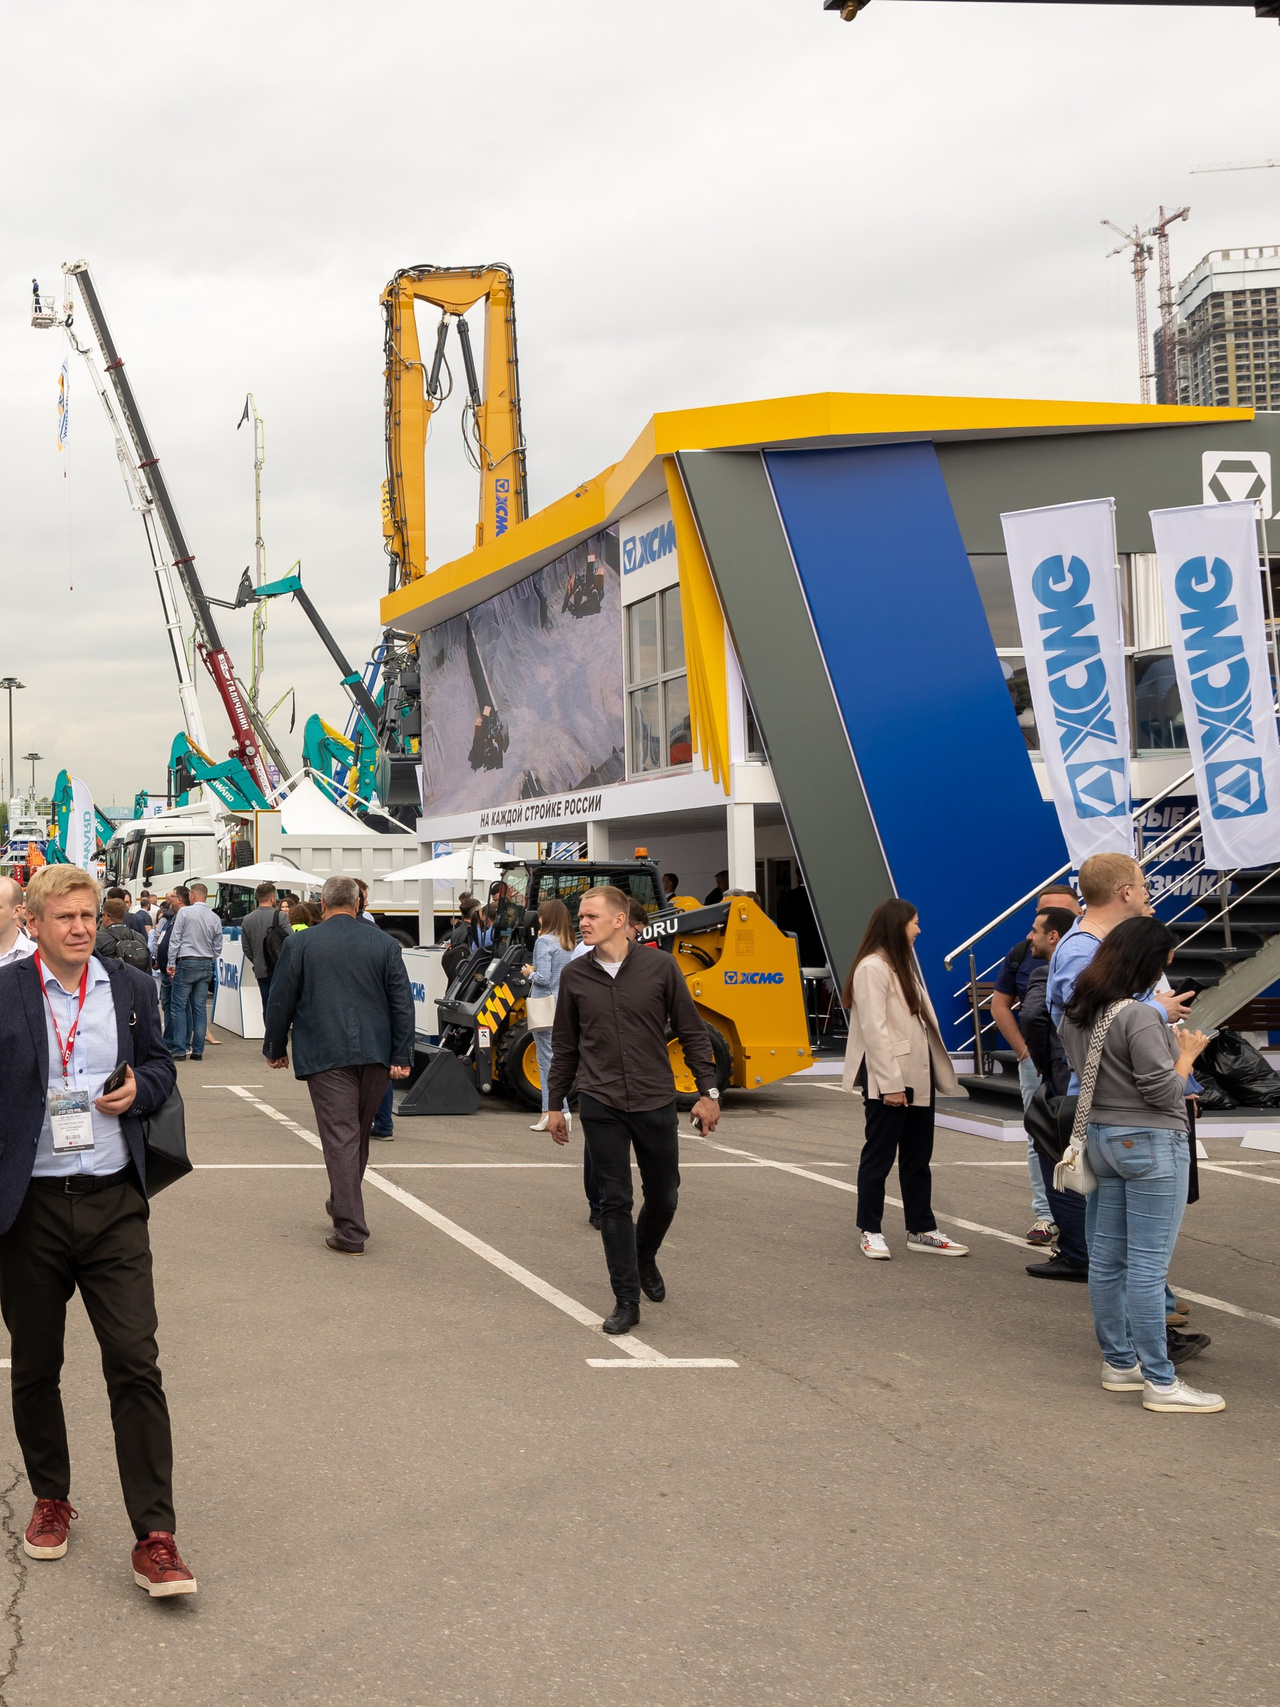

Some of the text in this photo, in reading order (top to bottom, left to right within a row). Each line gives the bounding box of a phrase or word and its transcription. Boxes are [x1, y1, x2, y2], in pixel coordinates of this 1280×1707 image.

[494, 493, 509, 538] XCM
[636, 519, 677, 570] XCM
[226, 680, 249, 731] ГАЛИЧАНИН
[480, 794, 602, 828] НА КАЖДОЙ СТРОЙКЕ РОССИИ
[638, 918, 679, 942] 0RU
[739, 971, 785, 985] XCMG
